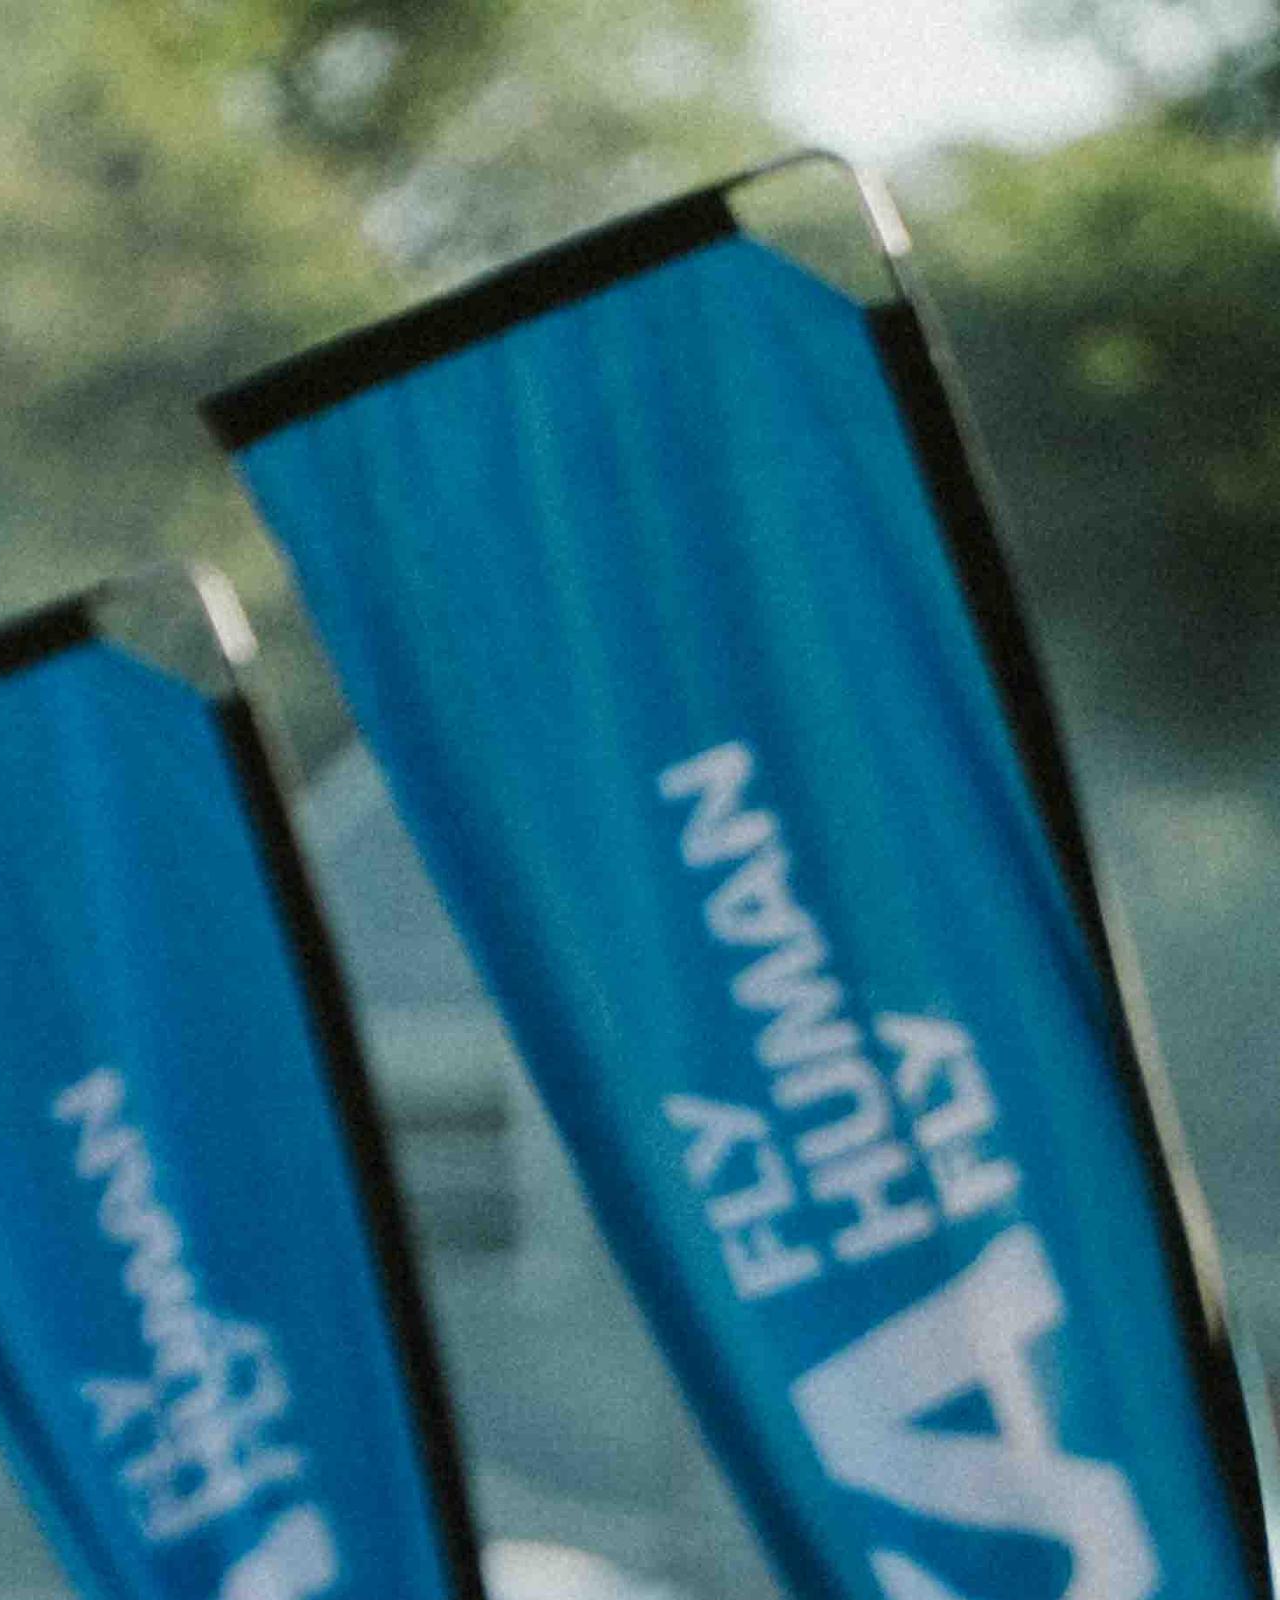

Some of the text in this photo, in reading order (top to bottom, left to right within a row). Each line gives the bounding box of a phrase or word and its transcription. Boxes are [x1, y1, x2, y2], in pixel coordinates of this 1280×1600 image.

[657, 738, 937, 1264] HUMAN
[657, 1092, 824, 1303] FLY
[870, 1008, 1024, 1224] FLY
